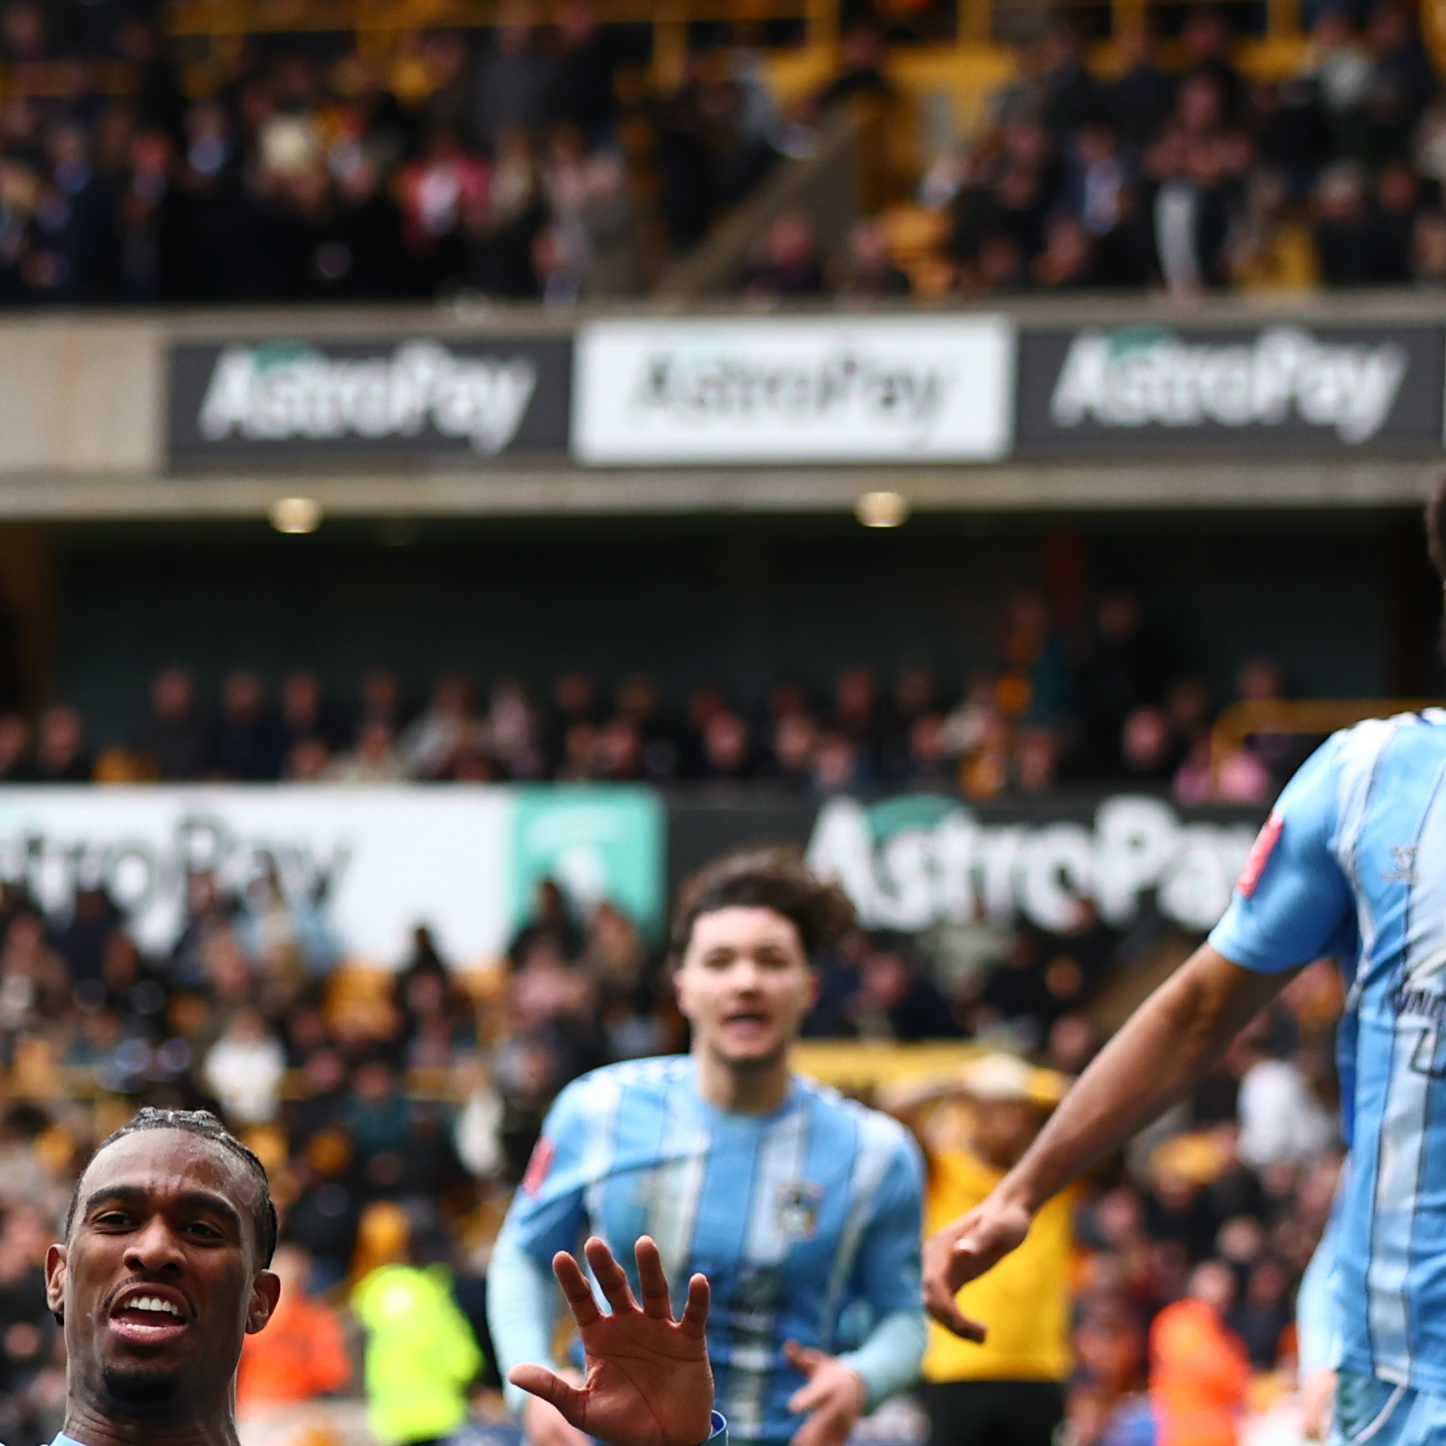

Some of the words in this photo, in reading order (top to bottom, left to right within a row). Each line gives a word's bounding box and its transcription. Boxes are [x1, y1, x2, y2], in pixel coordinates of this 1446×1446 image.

[200, 343, 536, 453] AstroPay
[632, 350, 950, 448] AstroPay
[1050, 330, 1406, 442] AstroPay
[806, 795, 1256, 932] AstroPa
